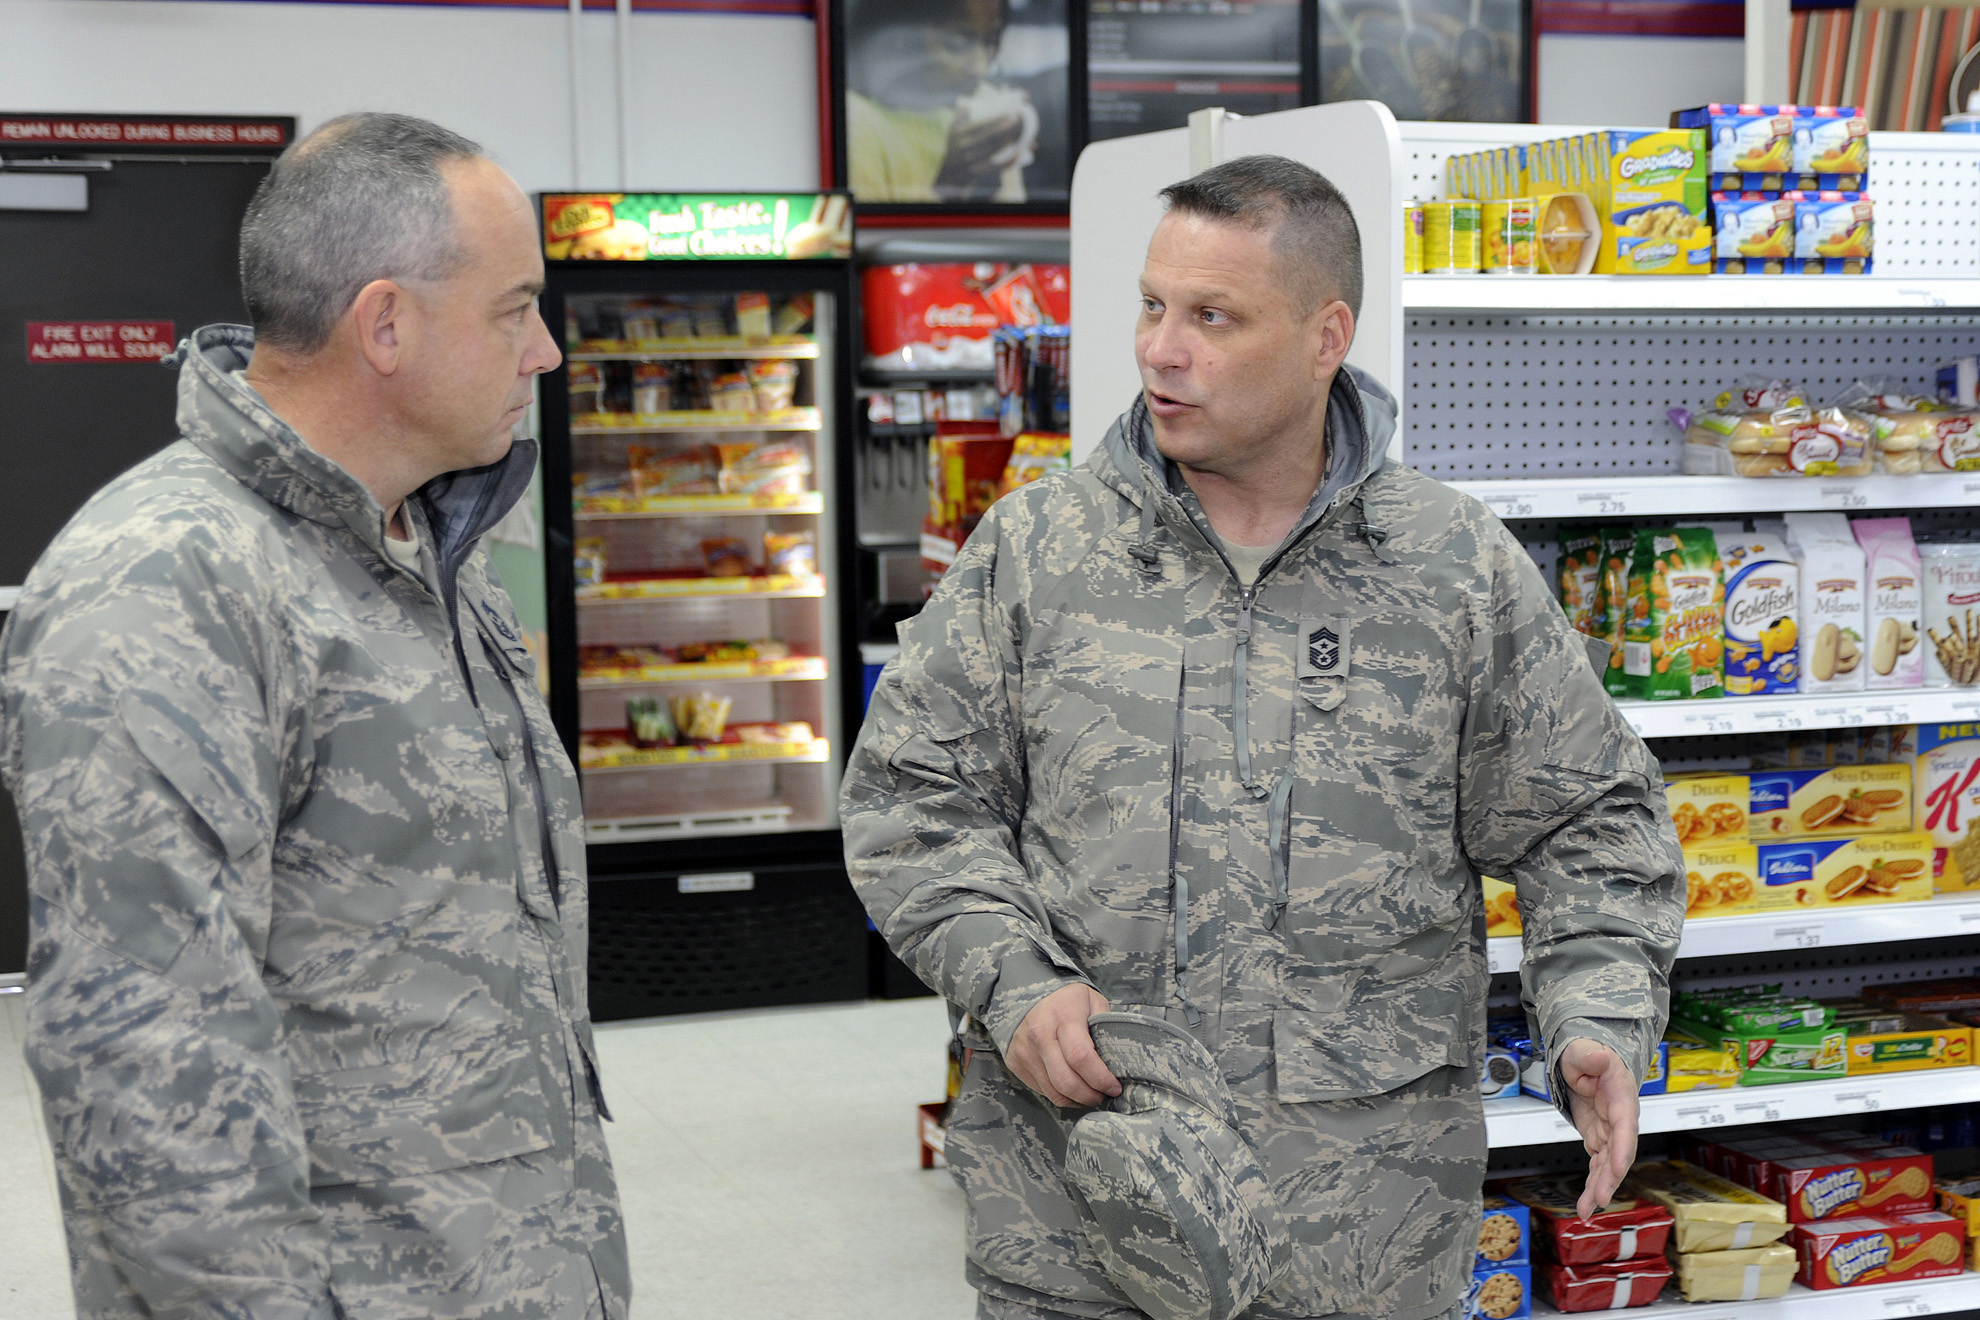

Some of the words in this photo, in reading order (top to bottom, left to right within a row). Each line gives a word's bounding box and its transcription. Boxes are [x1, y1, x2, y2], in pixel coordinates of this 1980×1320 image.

[2, 122, 51, 139] REMAIN
[53, 122, 122, 140] UNLOCKED
[124, 123, 171, 140] DURING
[173, 124, 235, 141] BUSINESS
[237, 125, 280, 142] HOURS
[42, 325, 76, 342] FIRE
[80, 325, 115, 341] EXIT
[119, 325, 157, 342] ONLY
[31, 342, 82, 359] ALARM
[84, 342, 120, 359] WILL
[124, 341, 173, 358] SOUND
[1506, 504, 1532, 515] 2.90
[1600, 502, 1626, 513] 2.75
[1731, 585, 1794, 626] Goldfish
[1813, 595, 1861, 614] Milano
[1874, 592, 1919, 611] Milano
[1930, 757, 1968, 774] Special
[1925, 757, 1980, 833] K
[1796, 934, 1821, 947] 1.37
[1823, 1037, 1843, 1059] 12
[1804, 1167, 1857, 1203] Nutter
[1811, 1181, 1863, 1220] Butter
[1829, 1232, 1885, 1270] Nutter
[1838, 1247, 1891, 1286] Butter
